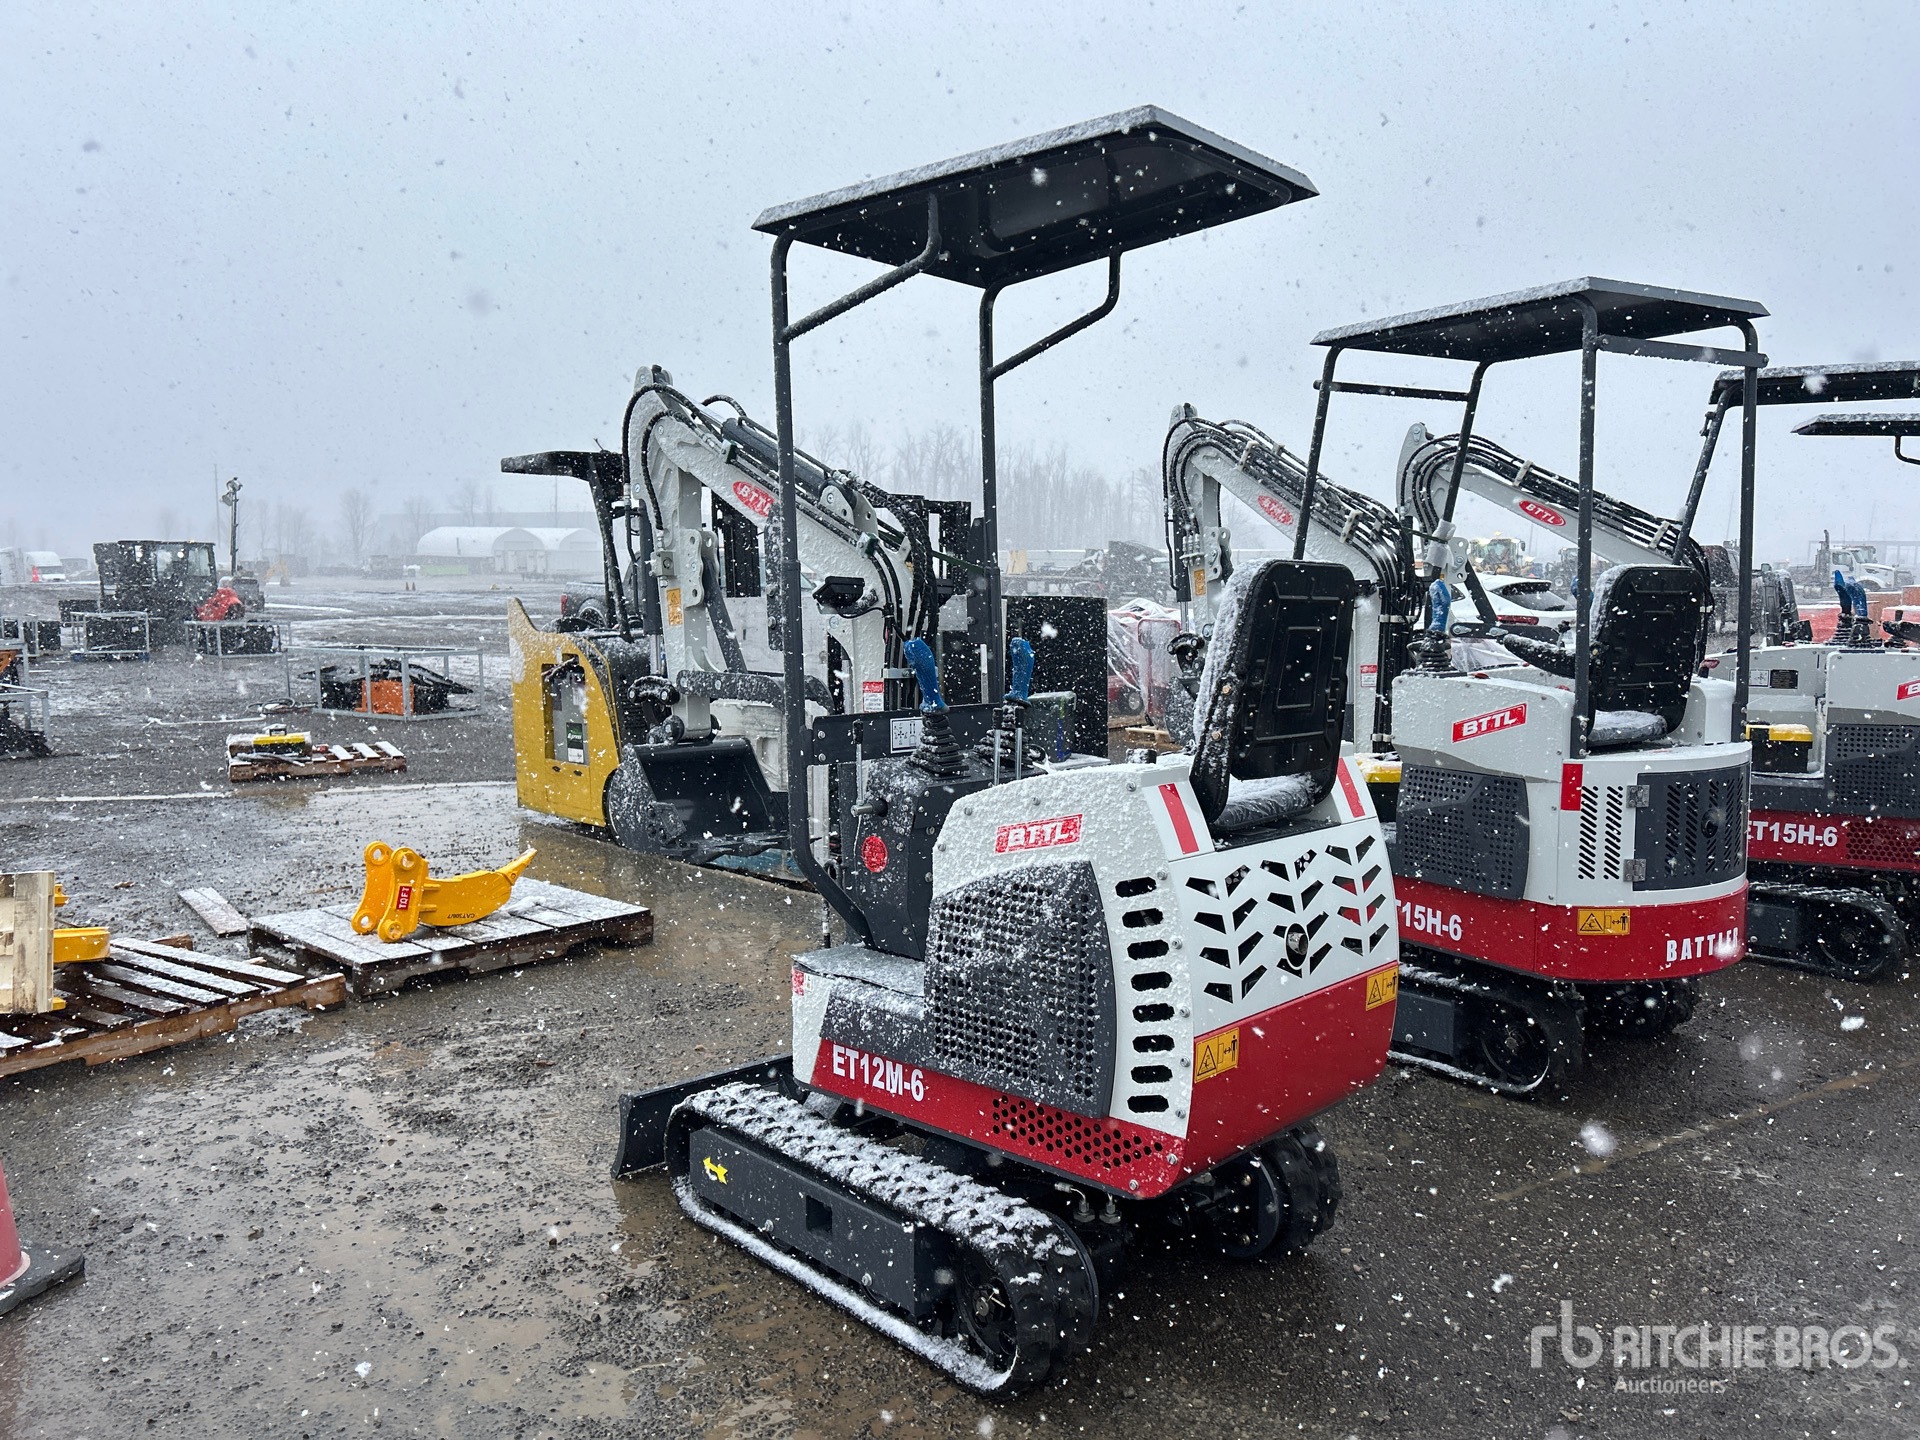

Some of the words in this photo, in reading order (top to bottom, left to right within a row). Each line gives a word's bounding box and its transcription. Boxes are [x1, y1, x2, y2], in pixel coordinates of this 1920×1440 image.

[1526, 503, 1555, 524] BTTL
[1462, 710, 1518, 737] BTTL
[1007, 822, 1070, 847] BTTL
[1395, 899, 1462, 941] 15H-6
[832, 1044, 925, 1102] ET12M-6
